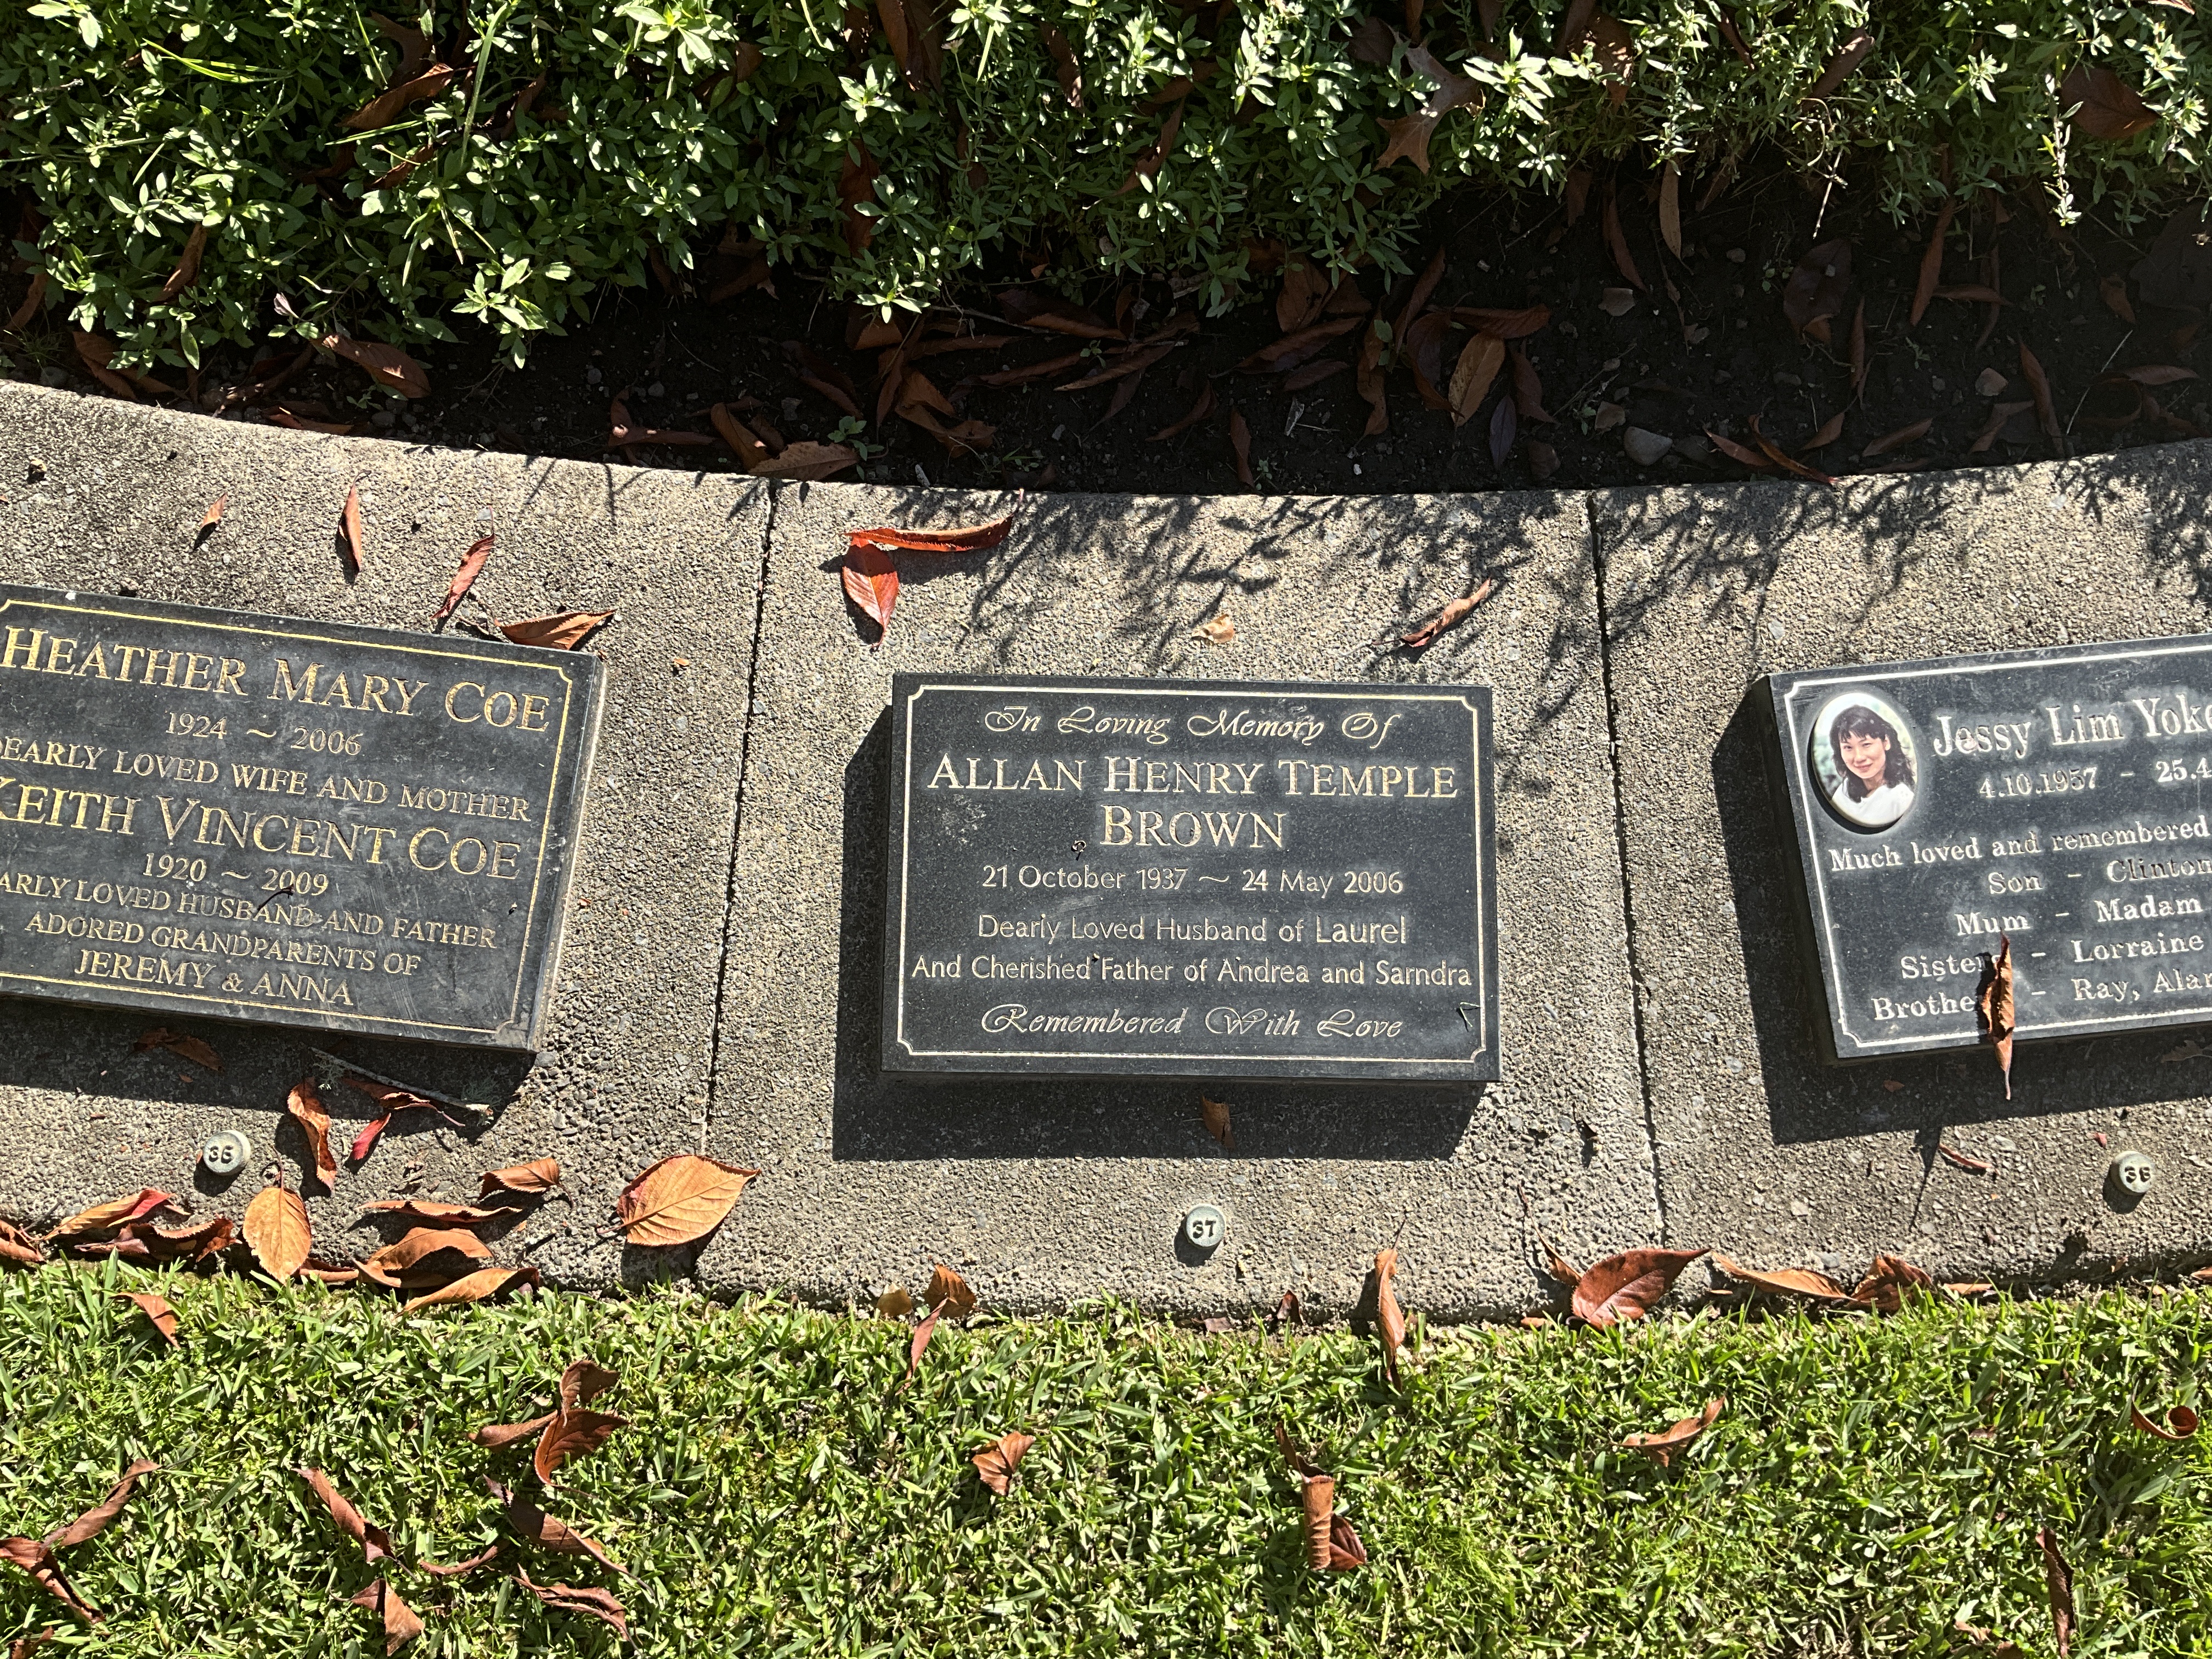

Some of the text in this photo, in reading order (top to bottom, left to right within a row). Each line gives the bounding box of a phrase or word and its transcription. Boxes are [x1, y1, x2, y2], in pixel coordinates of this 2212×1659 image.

[0, 625, 551, 732] HEATHER MARY COE
[166, 712, 227, 741] 1924
[291, 726, 362, 757] 2006
[985, 706, 1401, 749] In Loving Memory Of
[1933, 715, 2031, 758] Jessy
[2046, 704, 2124, 746] Lim
[0, 736, 532, 822] EARLY LOVED WIFE AND MOTHER
[928, 754, 1458, 798] ALLAN HENRY TEMPLE
[1979, 766, 2098, 800] 4.10.1957
[156, 794, 398, 865] VINCENT
[409, 826, 521, 880] COE
[1100, 805, 1286, 849] BROWN
[1828, 815, 2210, 873] Much loved and remembered
[143, 852, 207, 882] 1920
[262, 868, 330, 898] 2009
[983, 865, 1008, 889] 21
[1018, 865, 1126, 889] October
[1136, 868, 1188, 890] 1937
[1242, 868, 1269, 893] 24
[1280, 870, 1334, 900] May
[1344, 871, 1403, 894] 2006
[1988, 871, 2044, 895] Son
[2107, 858, 2212, 882] Clinton
[75, 879, 172, 911] LOVED
[177, 892, 319, 929] HUSBAND
[324, 909, 383, 935] AND
[391, 918, 498, 950] FATHER
[978, 913, 1407, 945] Dearly Loved Husband of Laurel
[1956, 911, 2030, 937] Mum
[2094, 895, 2204, 923] Madam
[24, 911, 422, 976] ADORED GRANDPARENTS OF
[2071, 932, 2204, 963] Lorraine
[74, 950, 355, 1006] JEREMY & ANNA
[912, 955, 1472, 988] And Cherished Father of Andrea and Sarndra
[981, 1003, 1402, 1038] Remembered With Love
[1871, 991, 1982, 1022] Brothe
[2073, 978, 2140, 1002] Ray,
[208, 1144, 234, 1164] 36
[1192, 1218, 1216, 1239] 37
